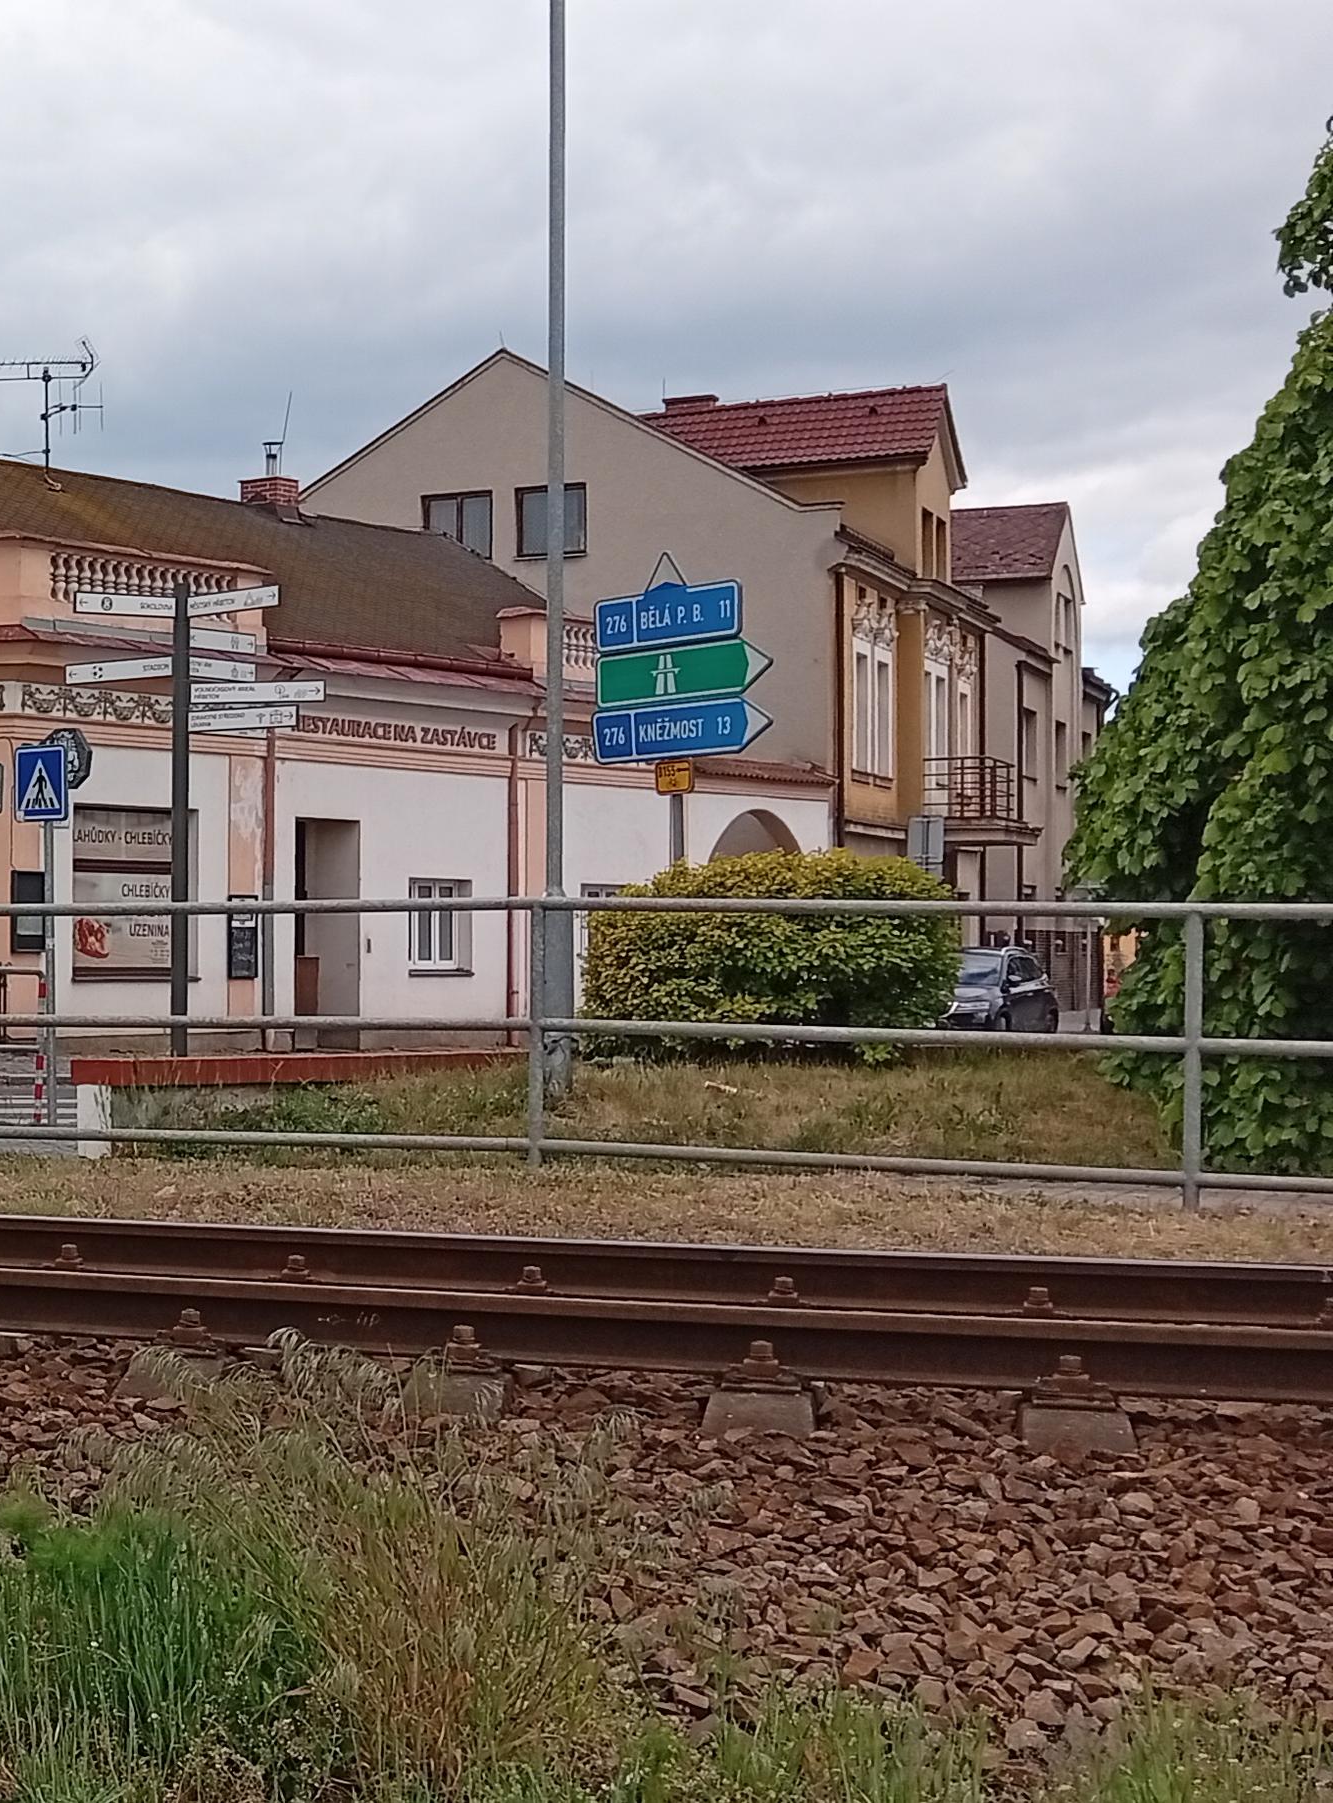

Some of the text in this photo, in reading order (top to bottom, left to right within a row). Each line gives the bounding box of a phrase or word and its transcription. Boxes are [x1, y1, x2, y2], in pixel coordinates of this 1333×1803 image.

[606, 599, 731, 635] 276 BĚLÁ P. B. 11
[394, 724, 417, 743] NA
[420, 726, 497, 750] ZASTÁVCE
[603, 716, 731, 746] 276 KNĚŽMOST 13
[124, 829, 172, 846] CHLEBÍČKY
[121, 882, 170, 898] CHLEBÍČKY
[129, 923, 169, 937] UZENINA
